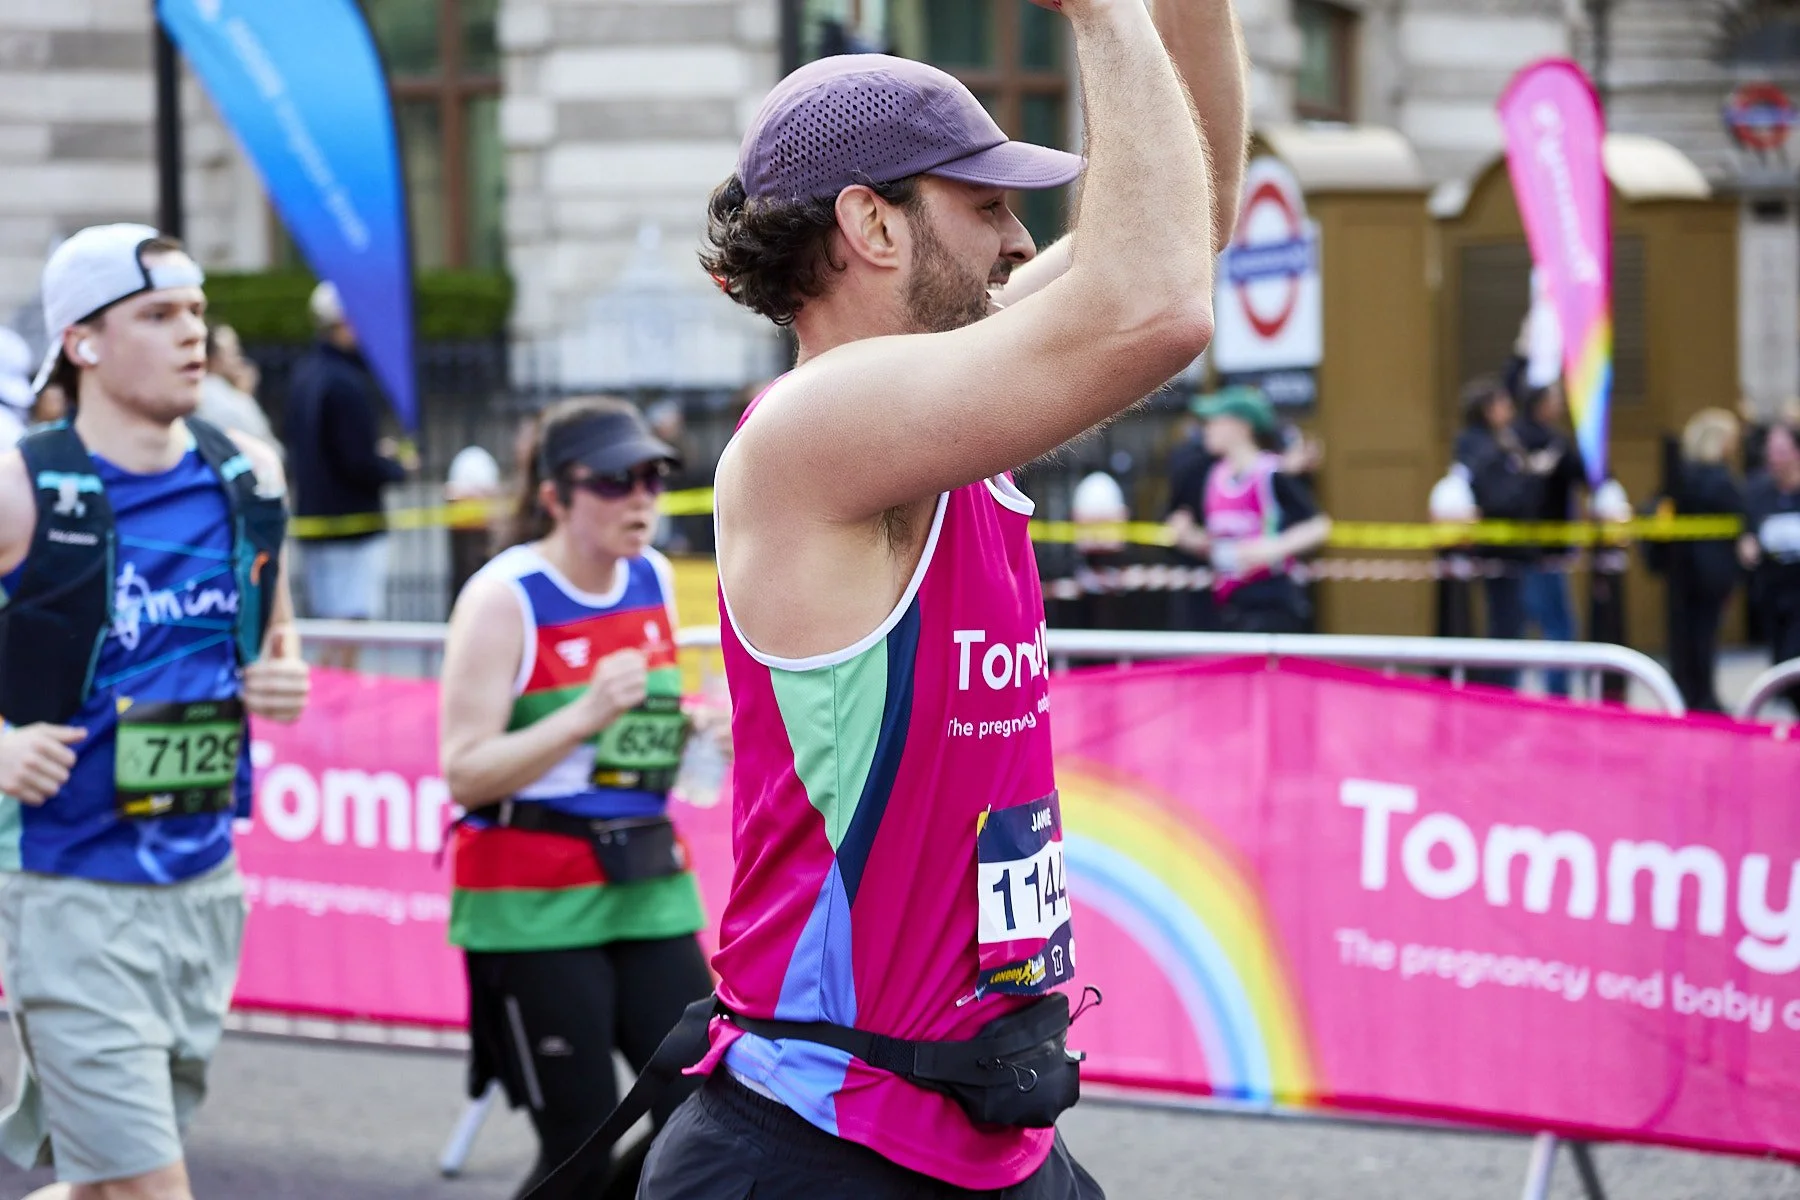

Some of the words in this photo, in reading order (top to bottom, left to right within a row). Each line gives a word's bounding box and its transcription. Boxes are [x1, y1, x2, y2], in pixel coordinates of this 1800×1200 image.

[1334, 927, 1397, 972] The
[1400, 943, 1591, 1002] pregnancy
[1595, 968, 1665, 1010] and
[1671, 970, 1774, 1033] baby
